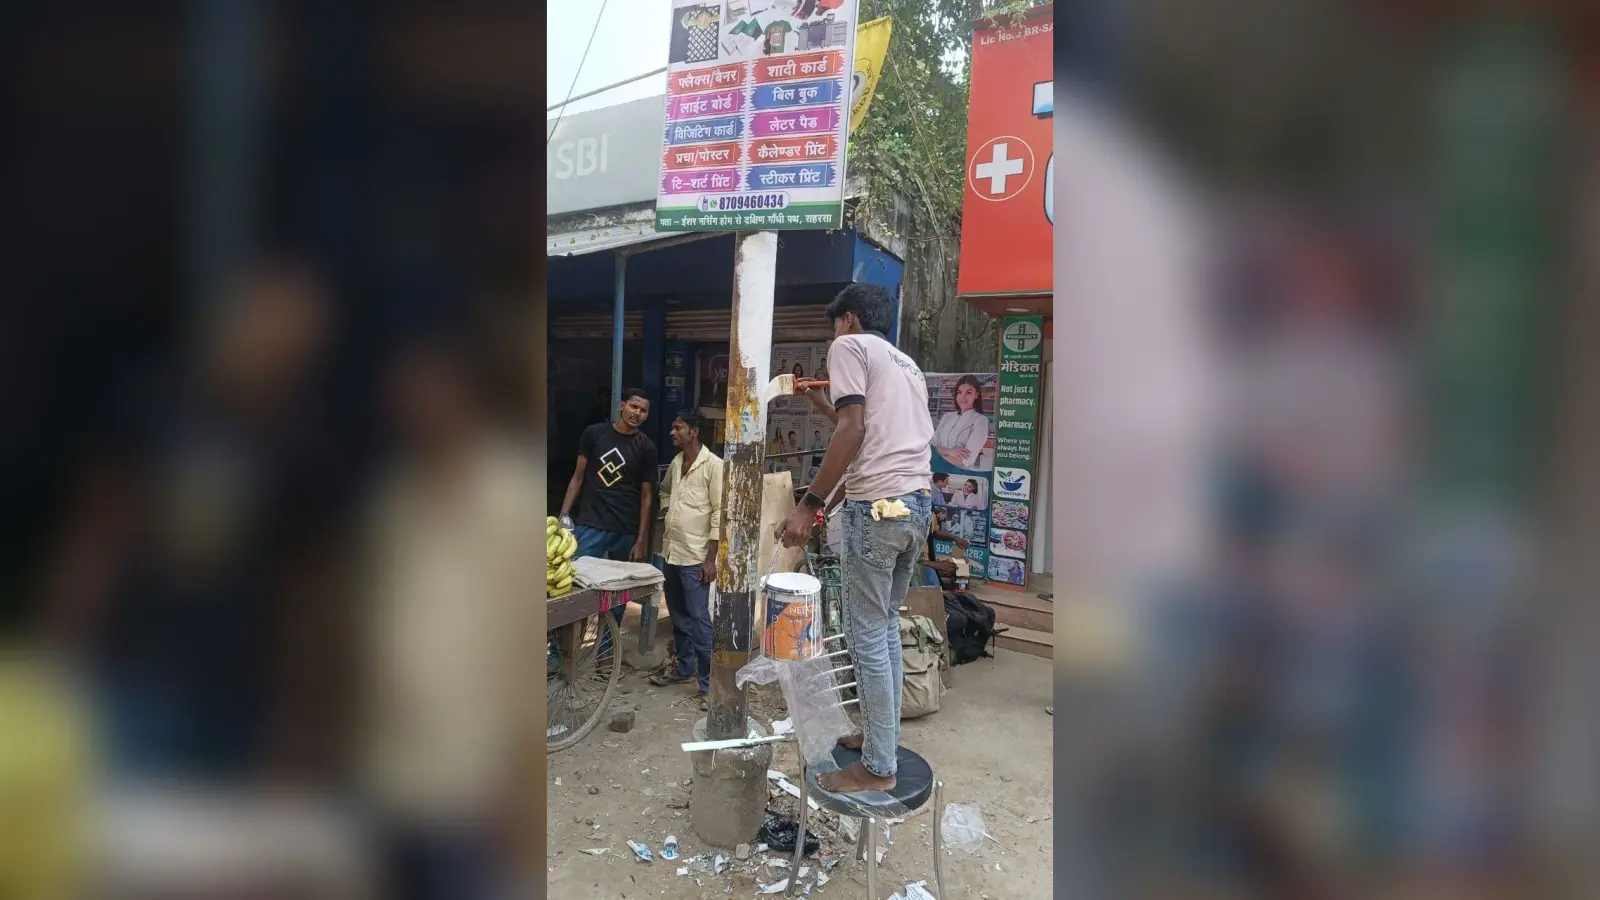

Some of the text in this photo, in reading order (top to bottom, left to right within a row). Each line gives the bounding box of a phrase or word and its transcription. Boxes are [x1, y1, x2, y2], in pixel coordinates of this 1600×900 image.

[980, 36, 995, 45] Lic
[766, 56, 828, 77] शादी कार्ड
[772, 87, 818, 104] बिल बुक
[680, 93, 732, 114] लाईट बोर्ड
[768, 114, 818, 131] लेटर पैड
[674, 120, 734, 140] विजिटिंग कार्ड
[757, 140, 826, 158] कैलेण्डर प्रिंट
[555, 133, 608, 180] SBI
[711, 174, 730, 188] प्रिंट
[759, 168, 821, 184] स्टीकर प्रिंट
[719, 194, 784, 210] 8709460434
[660, 218, 672, 227] पता
[720, 215, 733, 226] होम
[735, 214, 742, 225] से
[744, 213, 765, 225] दक्षिण
[805, 214, 832, 224] सहरसा
[1000, 360, 1040, 373] मेडिकल
[1000, 385, 1034, 395] Not just a
[999, 396, 1036, 406] pharmacy.
[999, 408, 1016, 417] Your
[998, 420, 1034, 430] pharmacy.
[997, 436, 1018, 444] Where
[1008, 453, 1032, 461] belong.
[996, 490, 1028, 498] pharmacy
